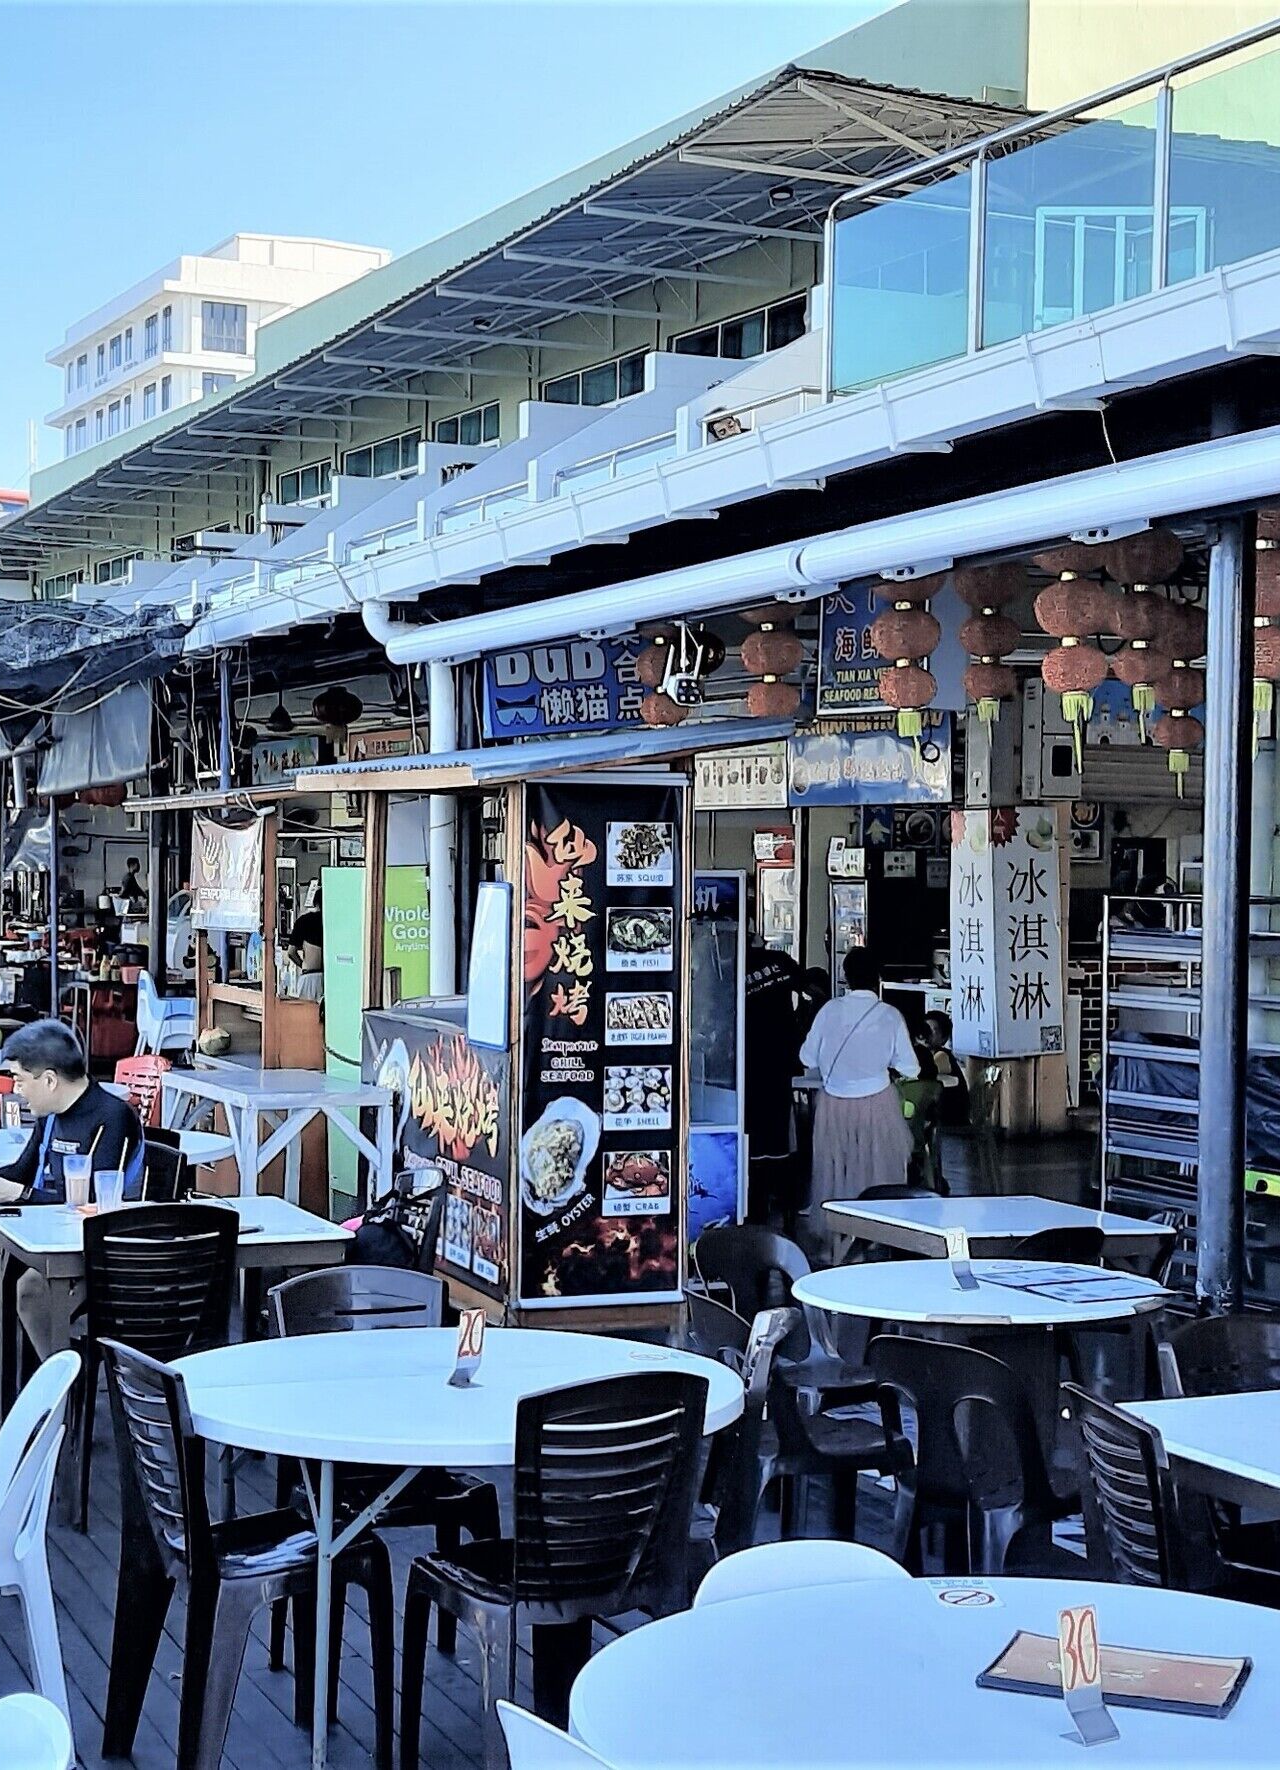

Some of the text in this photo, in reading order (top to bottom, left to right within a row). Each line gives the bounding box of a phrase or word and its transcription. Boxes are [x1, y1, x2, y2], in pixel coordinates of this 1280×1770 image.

[836, 670, 855, 684] TIAN
[857, 668, 871, 681] XIA
[541, 684, 609, 726] 懒猫
[824, 687, 862, 703] SEAFOOD
[637, 874, 664, 883] SQUID
[958, 862, 985, 1022] 冰淇淋
[1006, 858, 1051, 1021] 冰淇淋
[540, 1070, 595, 1082] SEAFOOD
[551, 1057, 585, 1068] GRILL
[460, 1165, 503, 1206] SEAFOOD
[561, 1193, 596, 1226] OYSTER
[459, 1310, 485, 1357] 20
[1060, 1609, 1098, 1690] 30
